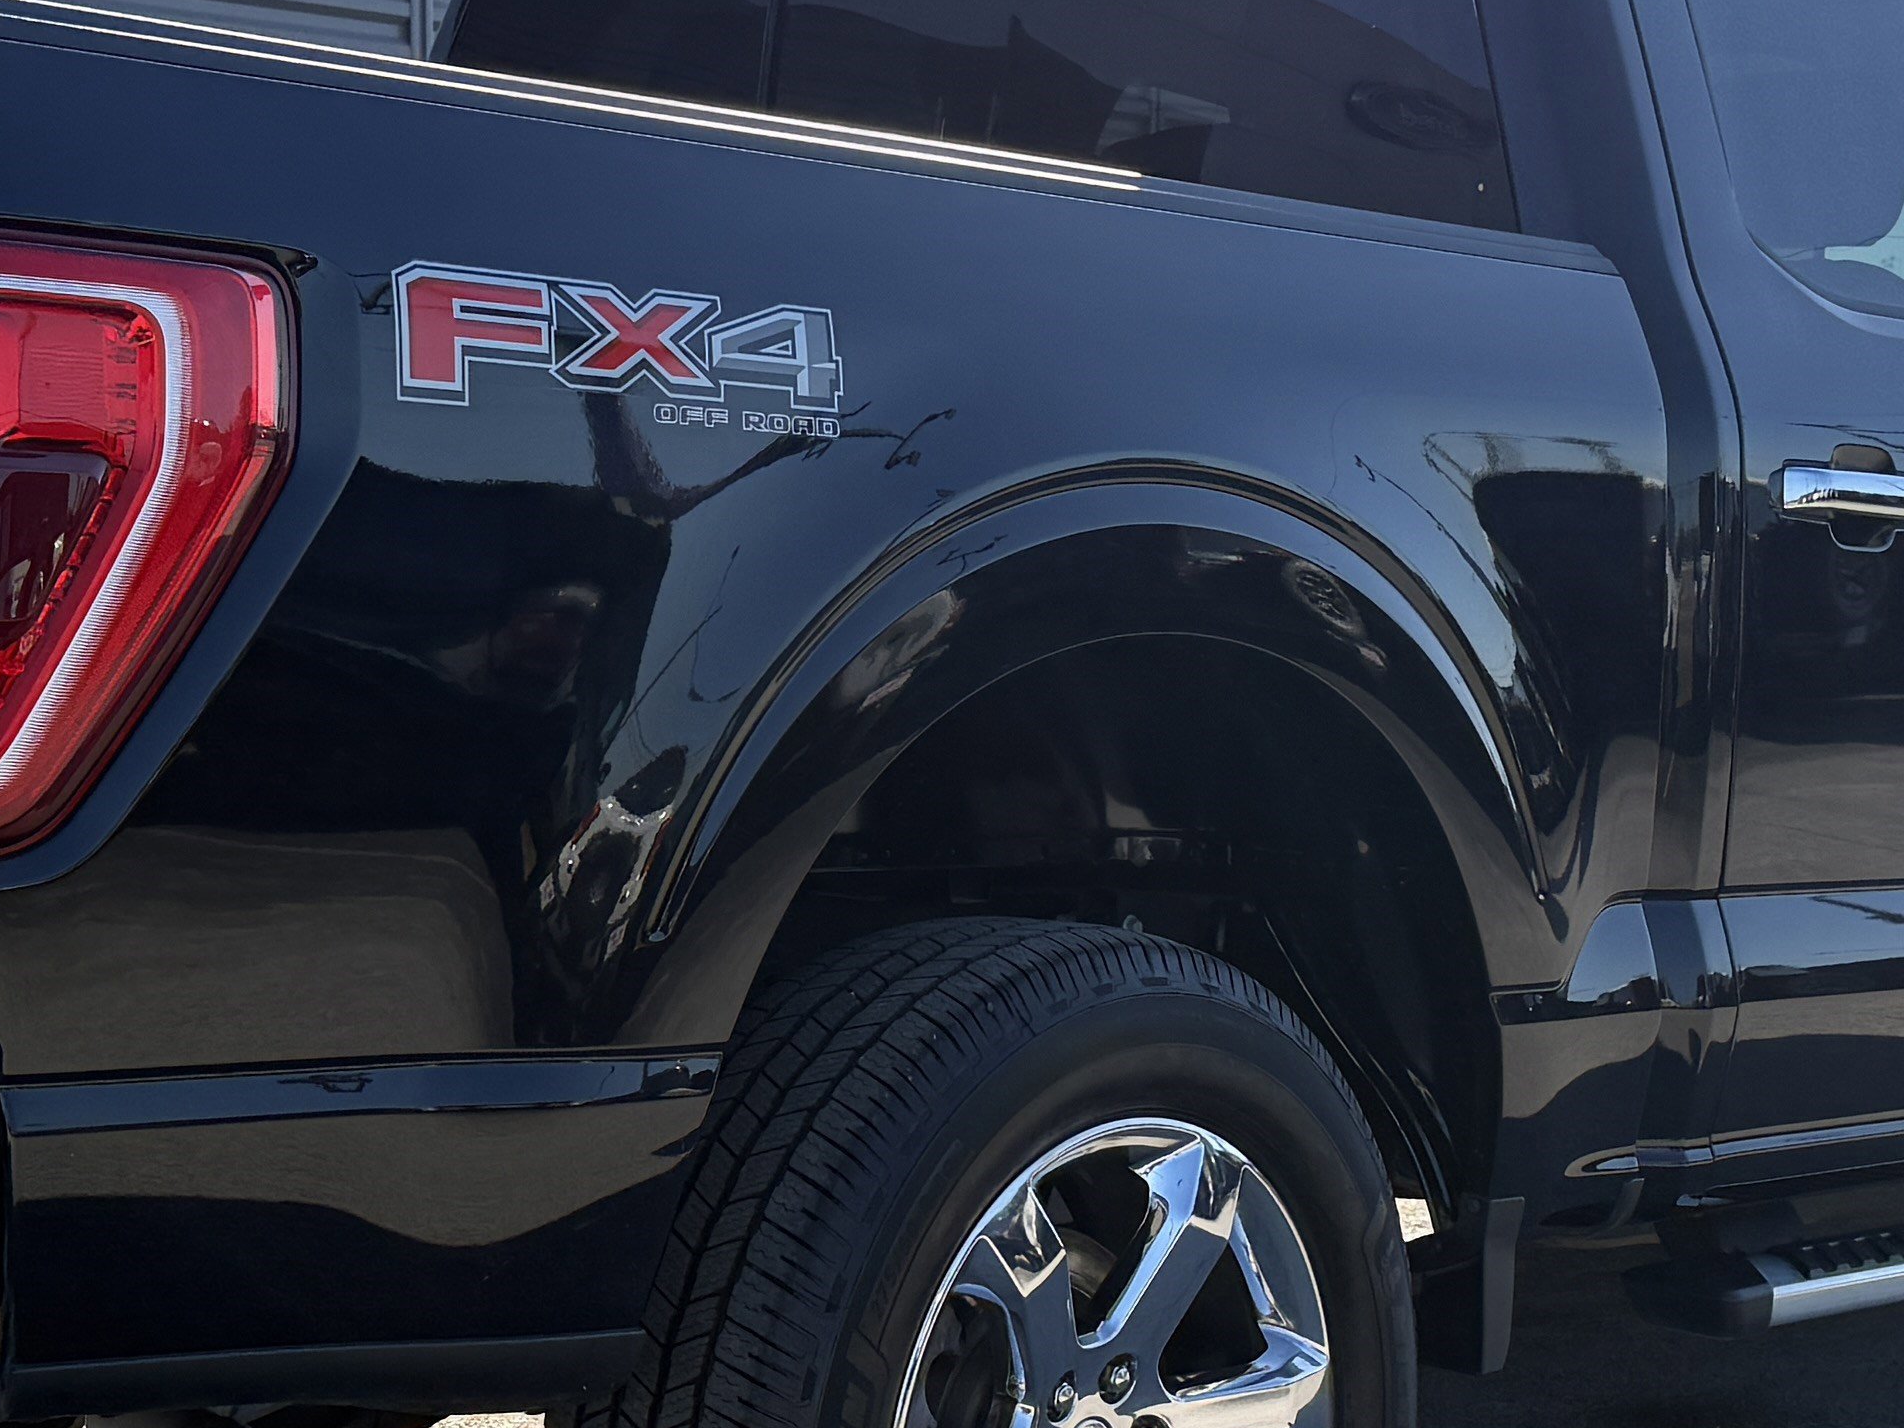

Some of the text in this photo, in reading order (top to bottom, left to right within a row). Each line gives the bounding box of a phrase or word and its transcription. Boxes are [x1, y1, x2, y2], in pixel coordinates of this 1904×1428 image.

[391, 260, 844, 412] FX4
[653, 403, 842, 440] OFF ROAD
